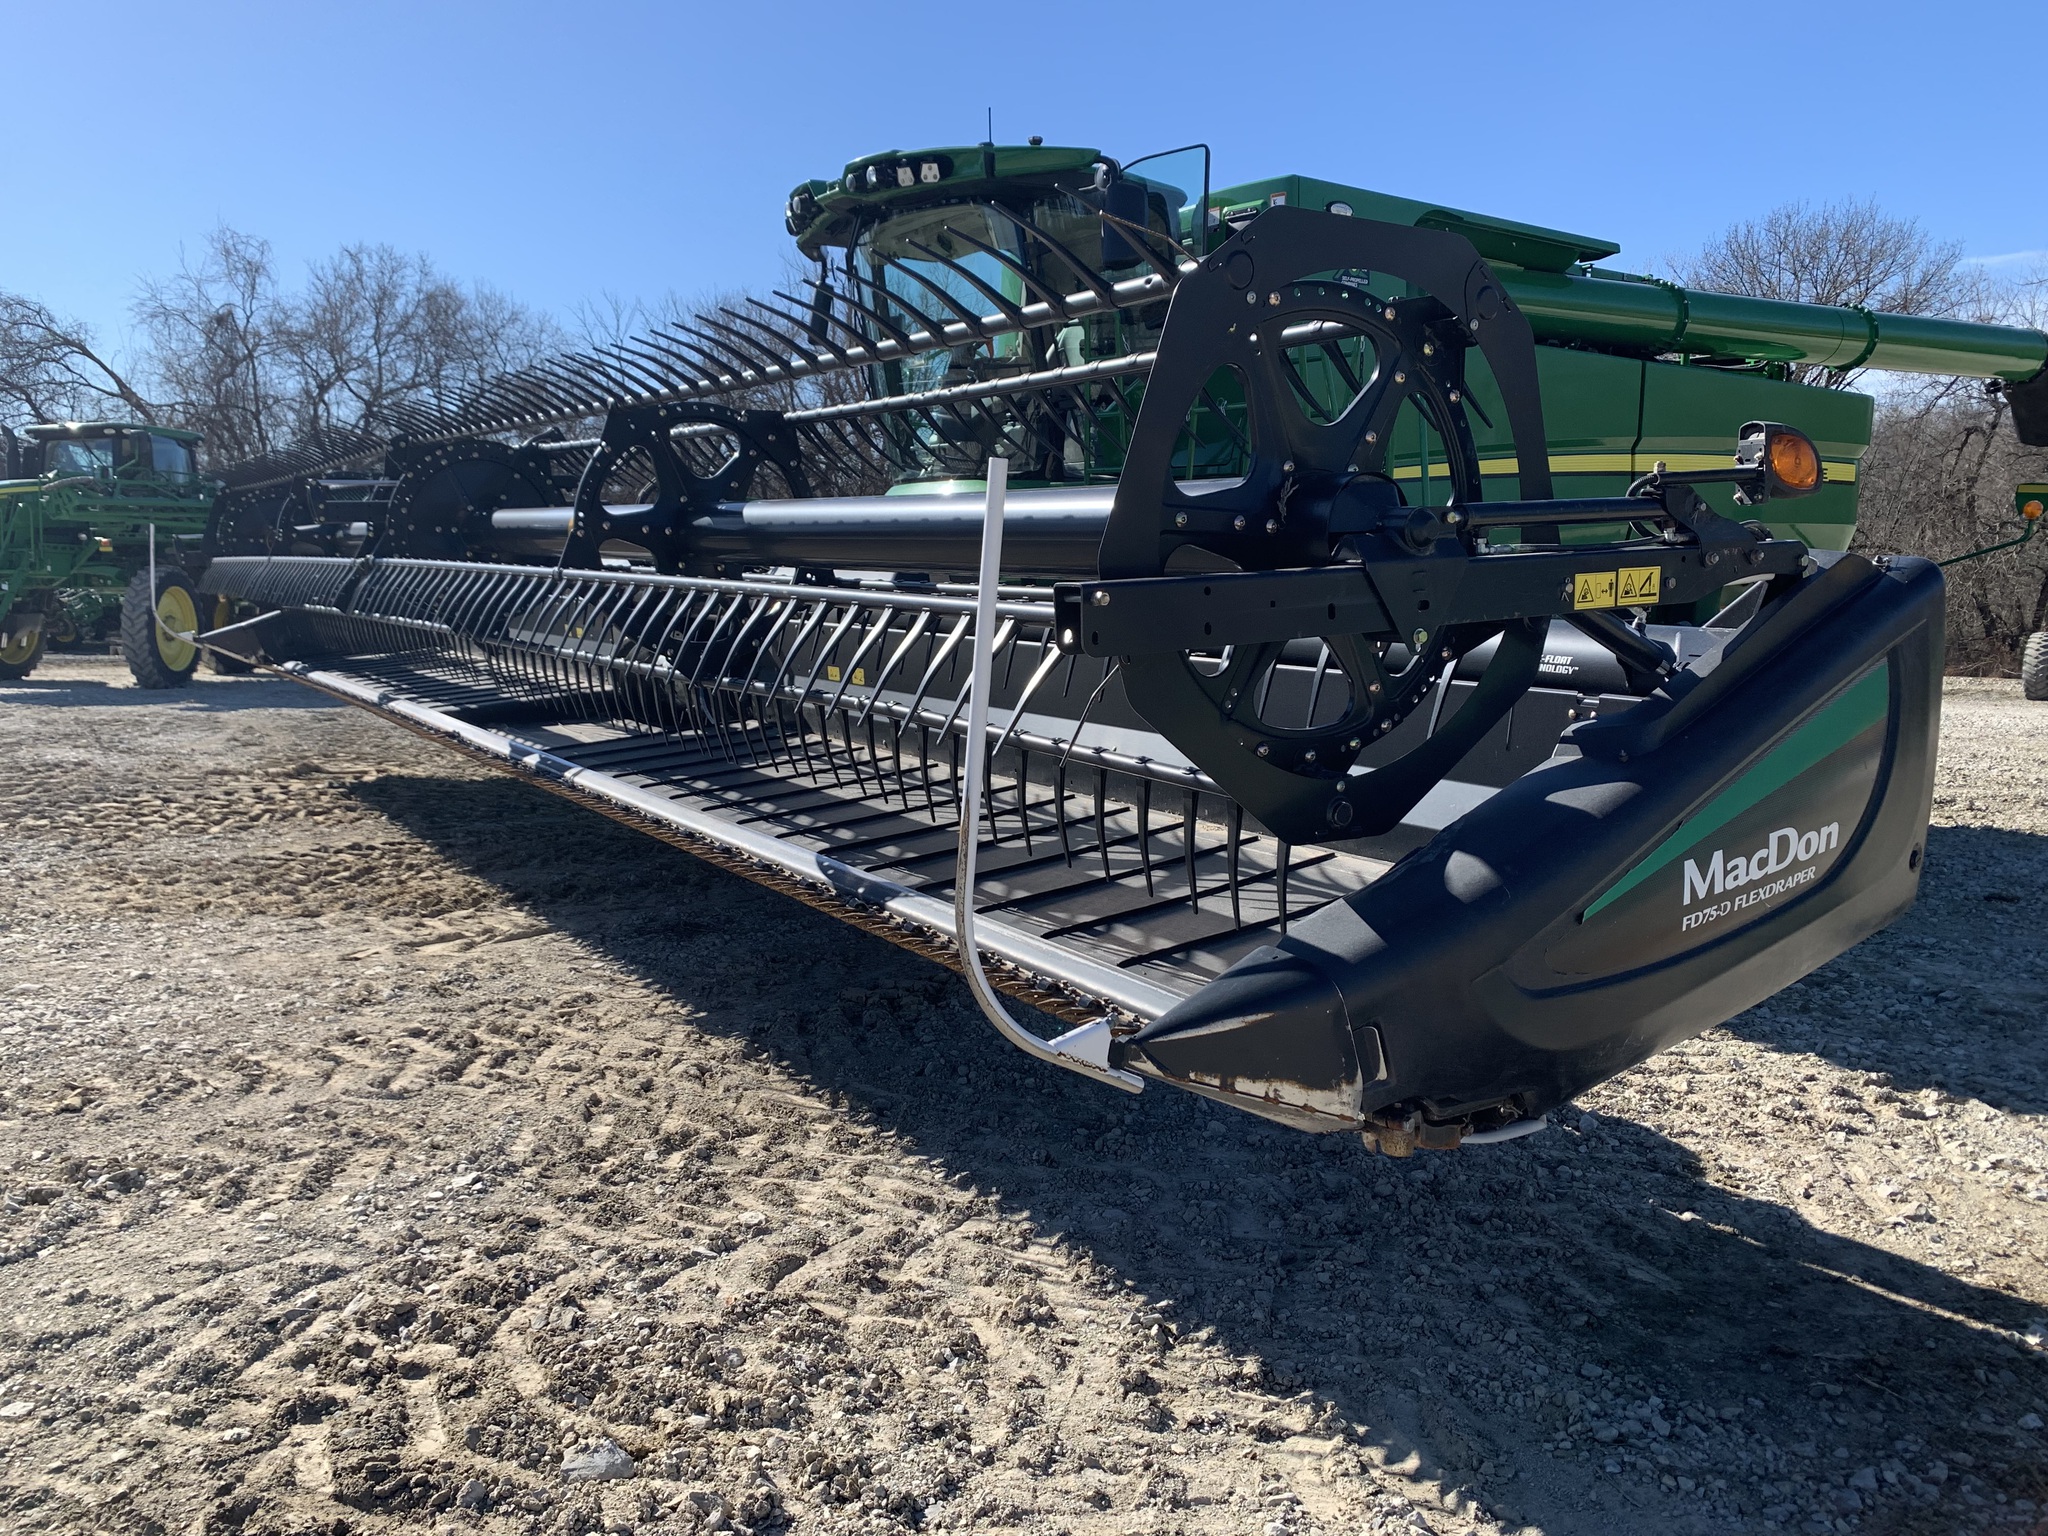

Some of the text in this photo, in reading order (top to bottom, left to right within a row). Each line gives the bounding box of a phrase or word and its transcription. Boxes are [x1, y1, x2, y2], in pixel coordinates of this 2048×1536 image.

[1682, 866, 1816, 932] FD75-D FLEXDRAPER
[1683, 821, 1839, 906] MacDon
